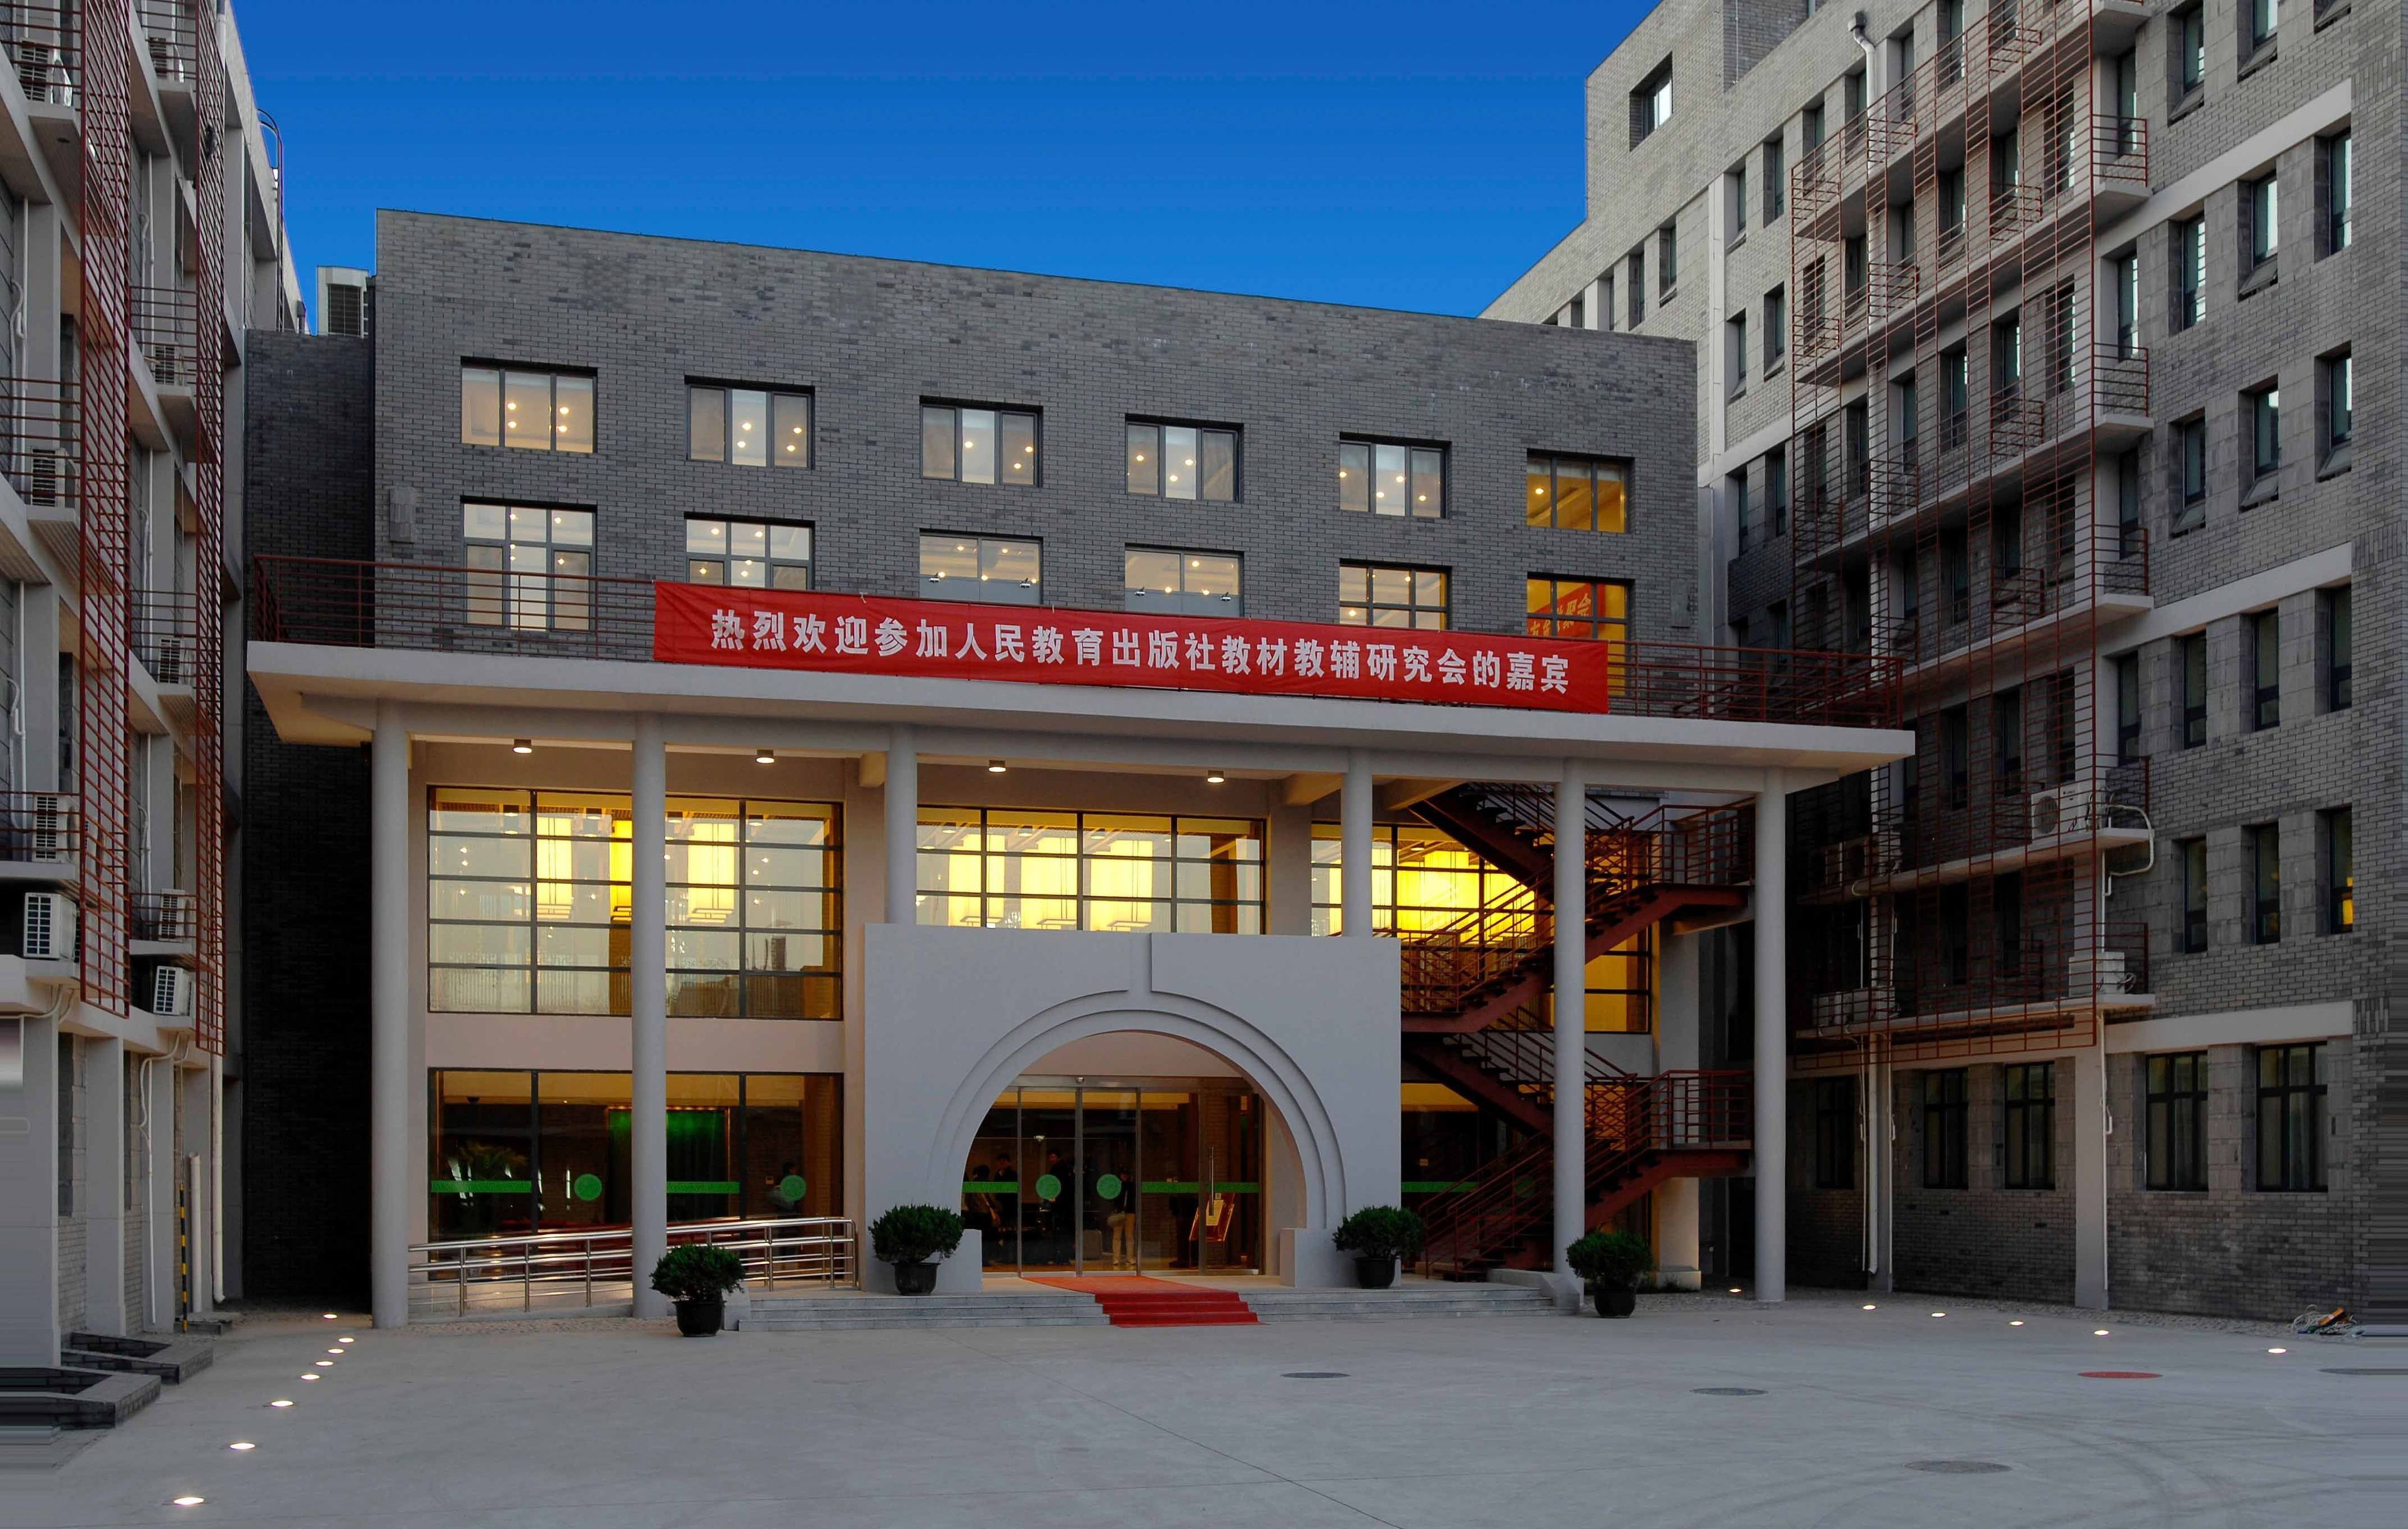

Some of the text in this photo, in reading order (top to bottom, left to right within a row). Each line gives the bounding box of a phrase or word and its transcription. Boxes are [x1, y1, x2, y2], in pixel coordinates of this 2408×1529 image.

[711, 609, 1569, 694] 热烈欢迎参加人民教育出版社教材教辅研究会的嘉宾
